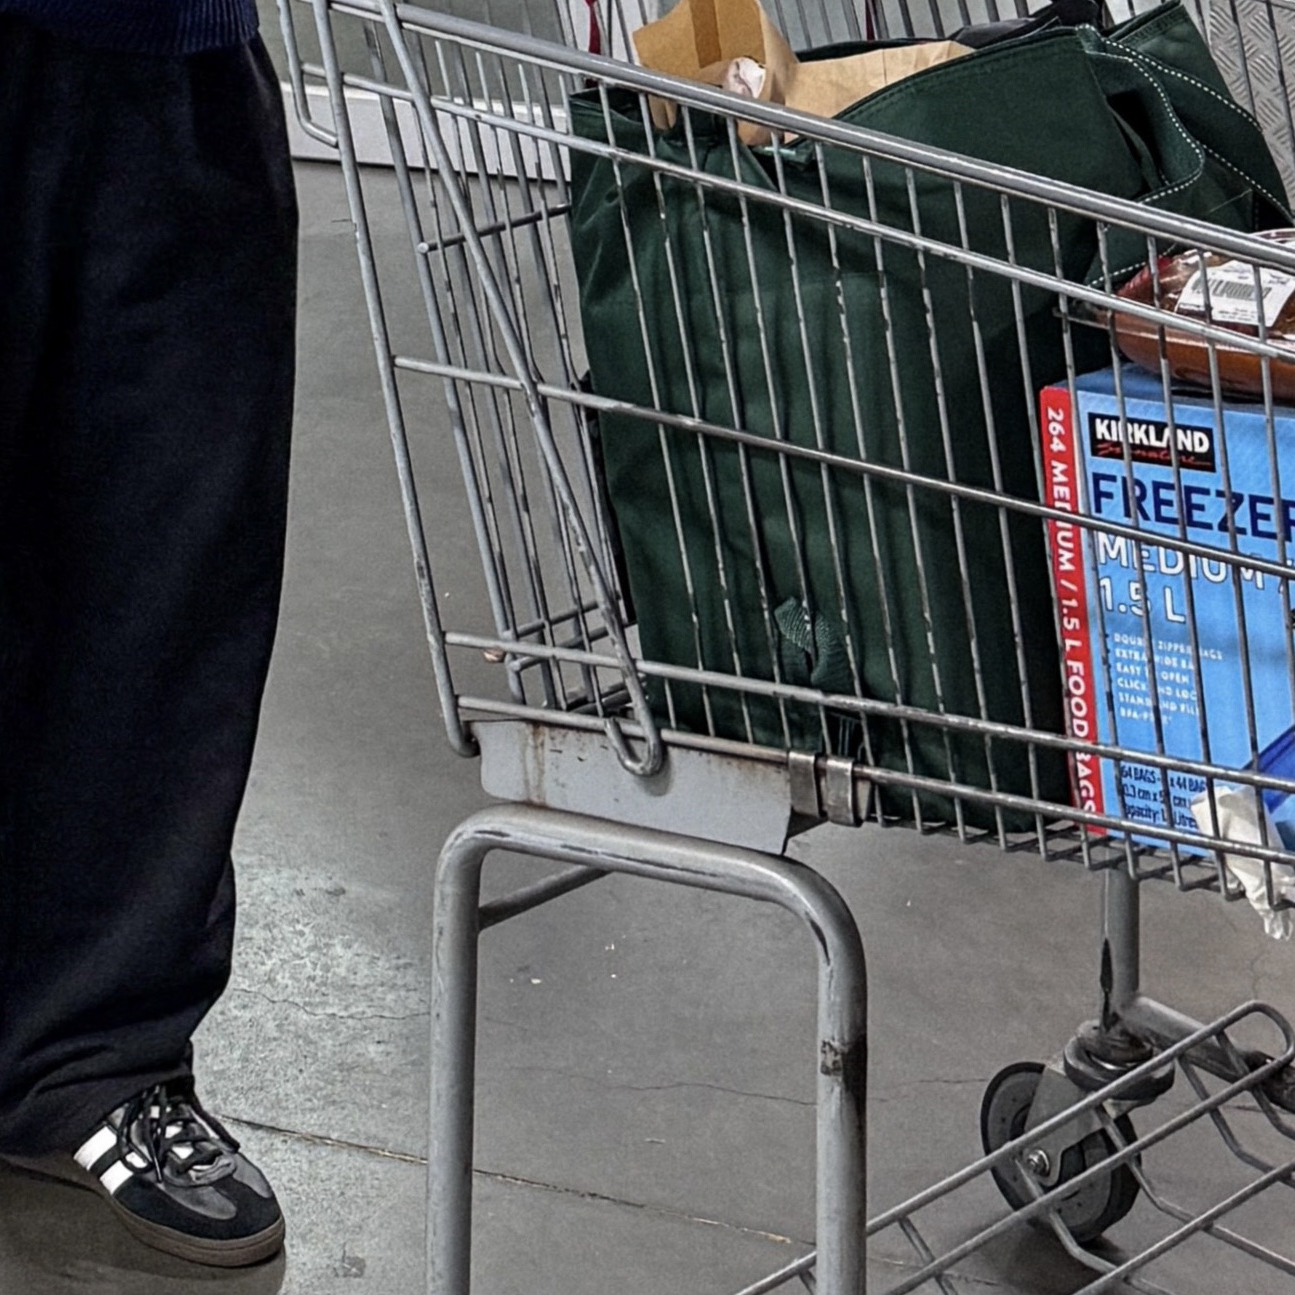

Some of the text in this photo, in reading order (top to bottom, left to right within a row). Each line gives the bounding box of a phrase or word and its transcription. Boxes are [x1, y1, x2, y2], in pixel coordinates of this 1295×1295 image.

[1048, 407, 1066, 452] 264
[1062, 598, 1080, 630] 1.5
[1100, 577, 1185, 624] 1.5 L
[1065, 639, 1082, 652] L
[1067, 659, 1089, 738] FOOD
